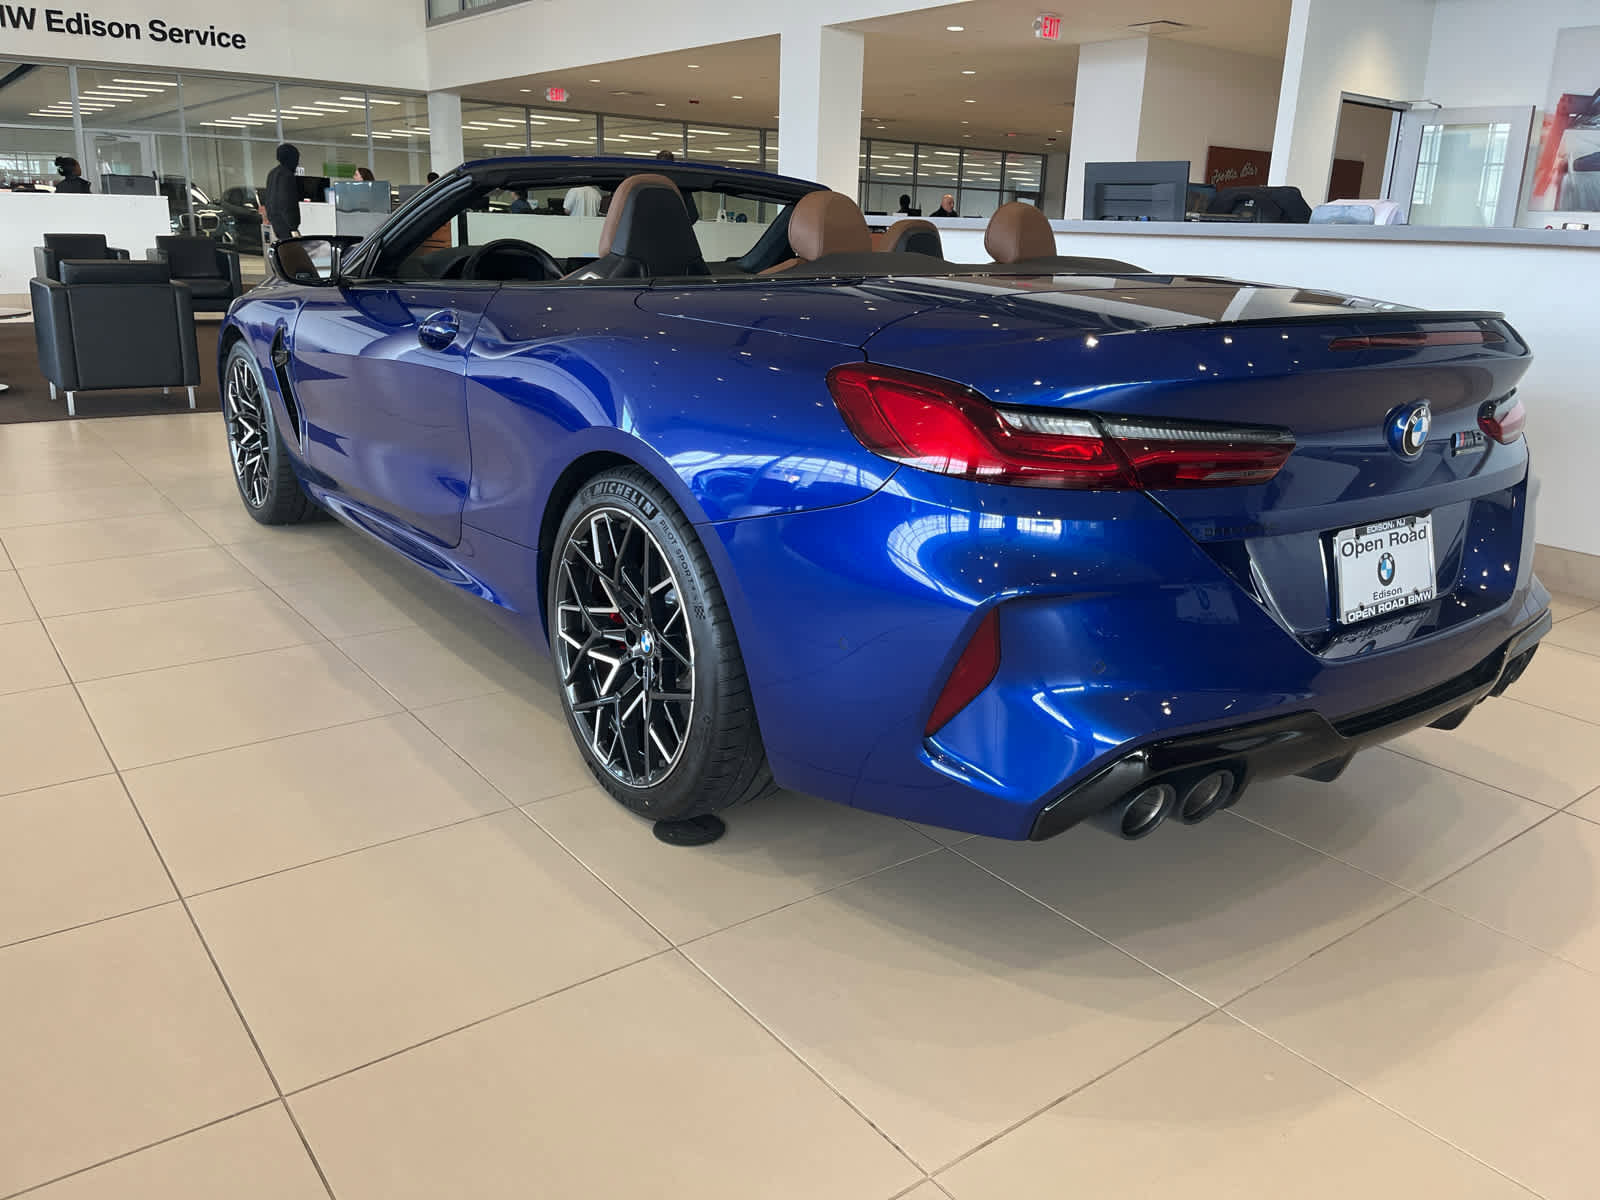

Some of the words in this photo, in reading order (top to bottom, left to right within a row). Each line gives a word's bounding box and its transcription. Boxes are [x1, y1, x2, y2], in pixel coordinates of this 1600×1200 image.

[45, 9, 141, 40] Edison
[148, 19, 247, 50] Service
[1042, 16, 1061, 39] EXIT
[594, 482, 655, 516] MICHELIN
[659, 519, 678, 545] PILOT
[675, 548, 694, 583] SPORT
[1342, 538, 1384, 558] Open
[1389, 525, 1427, 546] Road
[1348, 606, 1376, 623] OPEN
[1378, 597, 1406, 613] ROAD
[1408, 590, 1433, 605] BMW
[1373, 586, 1403, 601] Edison
